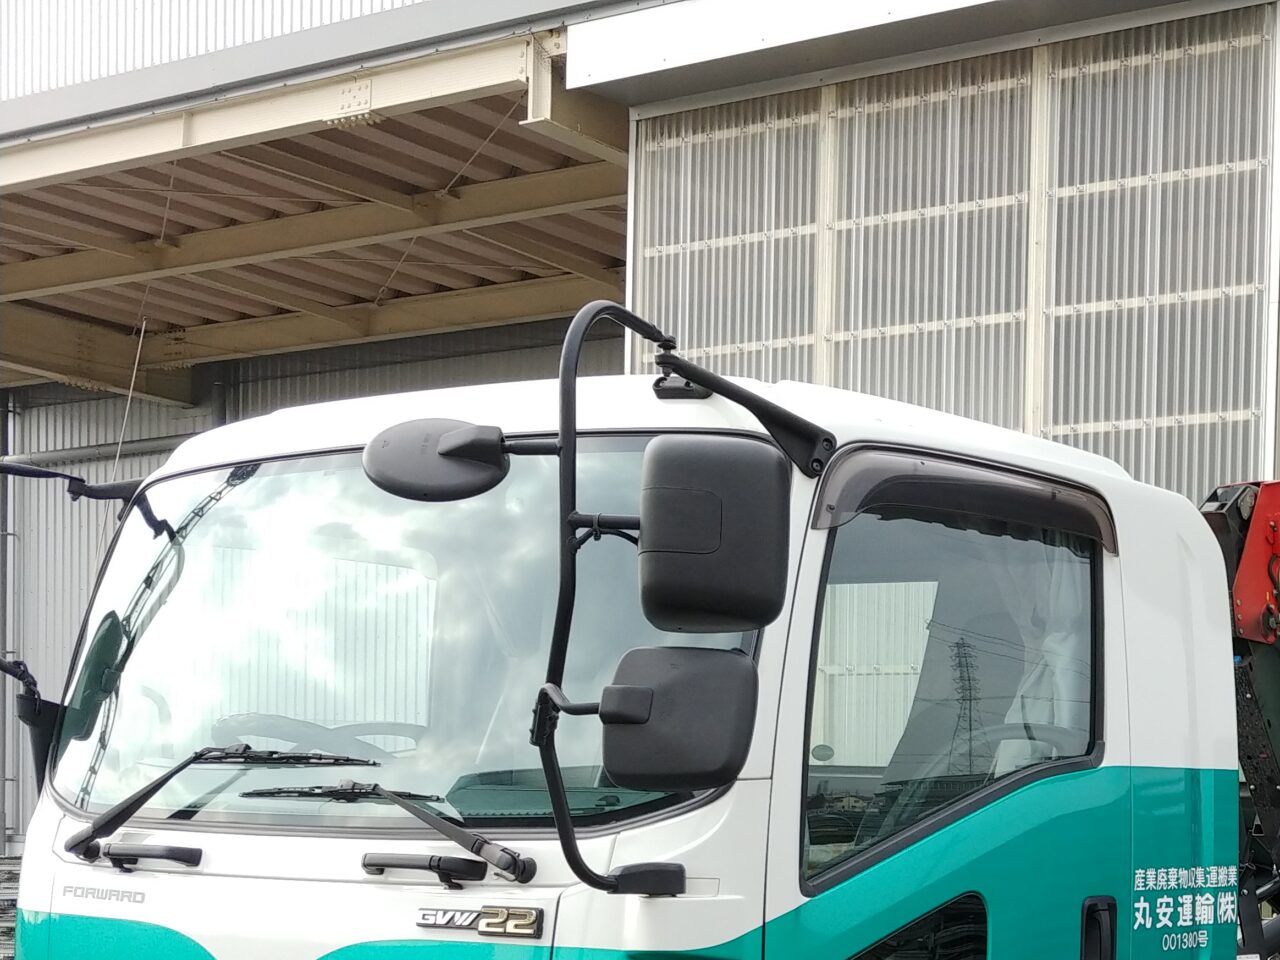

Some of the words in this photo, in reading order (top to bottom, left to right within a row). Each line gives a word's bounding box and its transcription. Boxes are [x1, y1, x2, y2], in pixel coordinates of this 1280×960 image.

[1134, 865, 1237, 891] 産業廃棄物収集運搬業
[63, 885, 145, 904] FORWARD
